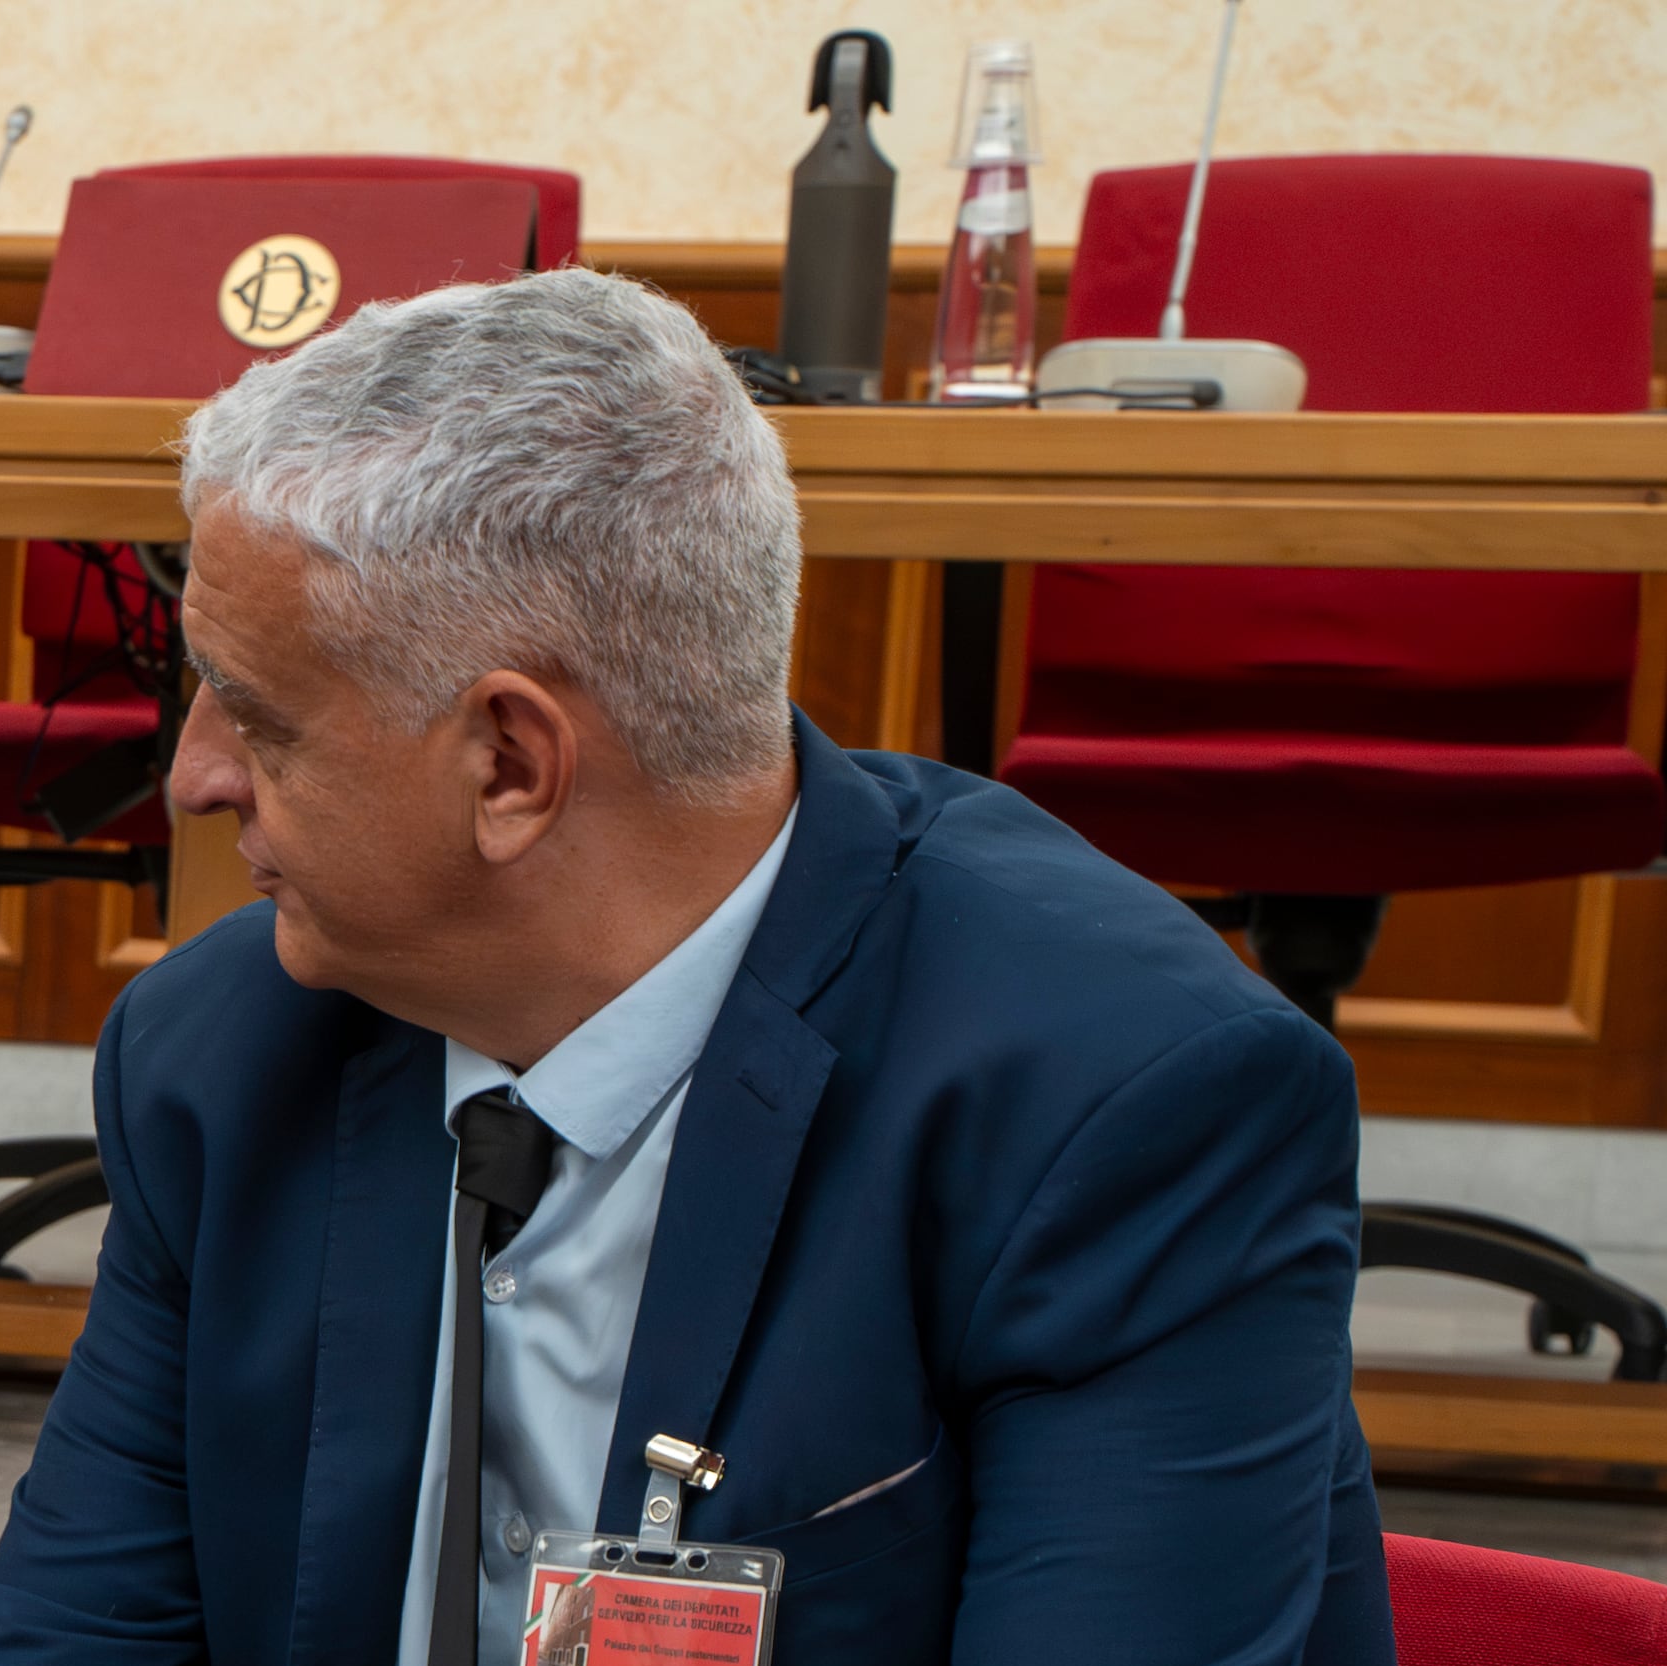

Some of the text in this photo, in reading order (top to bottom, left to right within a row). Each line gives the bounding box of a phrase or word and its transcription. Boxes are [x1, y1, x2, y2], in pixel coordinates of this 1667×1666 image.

[615, 1593, 740, 1618] CAMERA DEI DEPUTATI
[598, 1608, 753, 1635] SERVIZIO PER LA SICUREZZA
